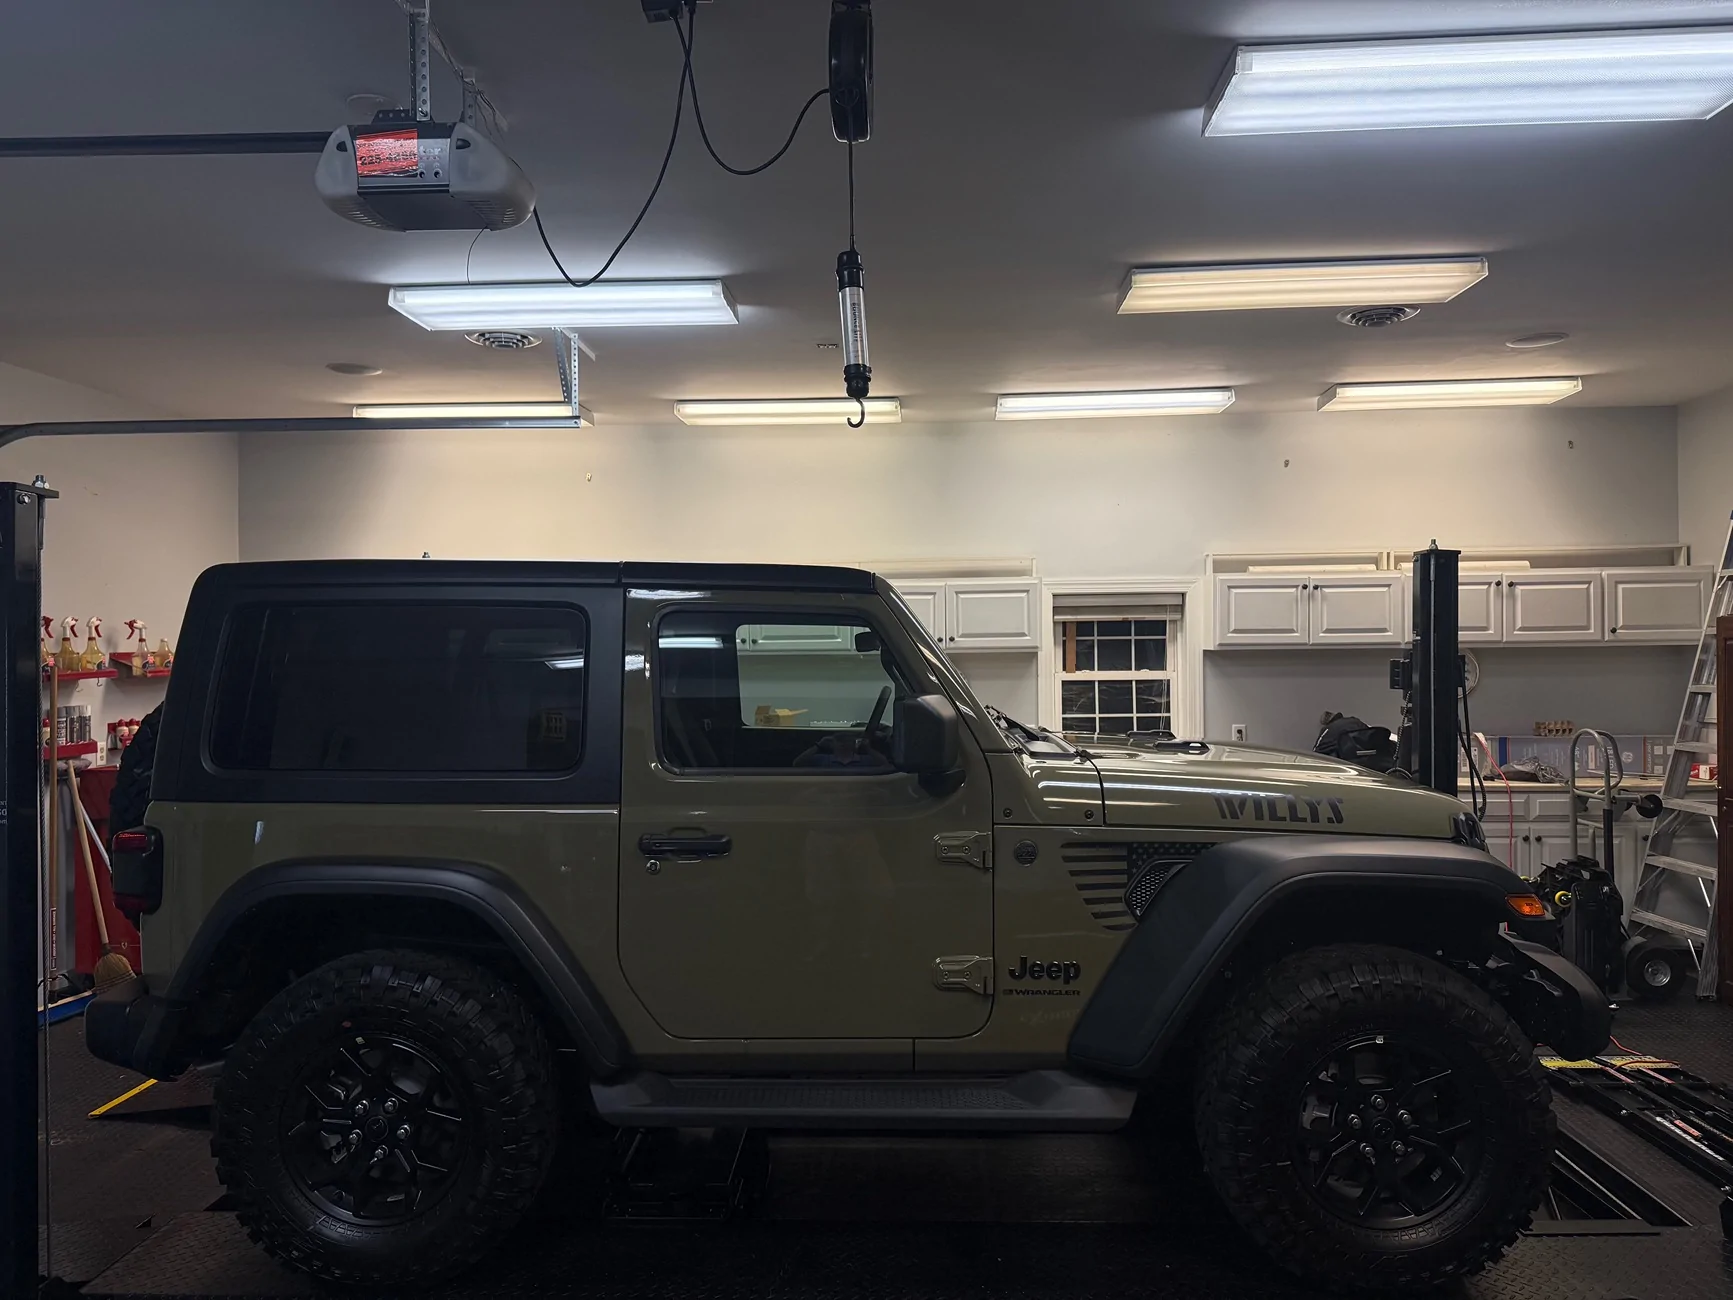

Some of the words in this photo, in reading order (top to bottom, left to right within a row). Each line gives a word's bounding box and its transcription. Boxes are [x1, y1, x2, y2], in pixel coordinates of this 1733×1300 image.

[1211, 792, 1344, 824] WILLYS
[1008, 955, 1081, 985] Jeep
[1014, 988, 1081, 996] WRANGLER
